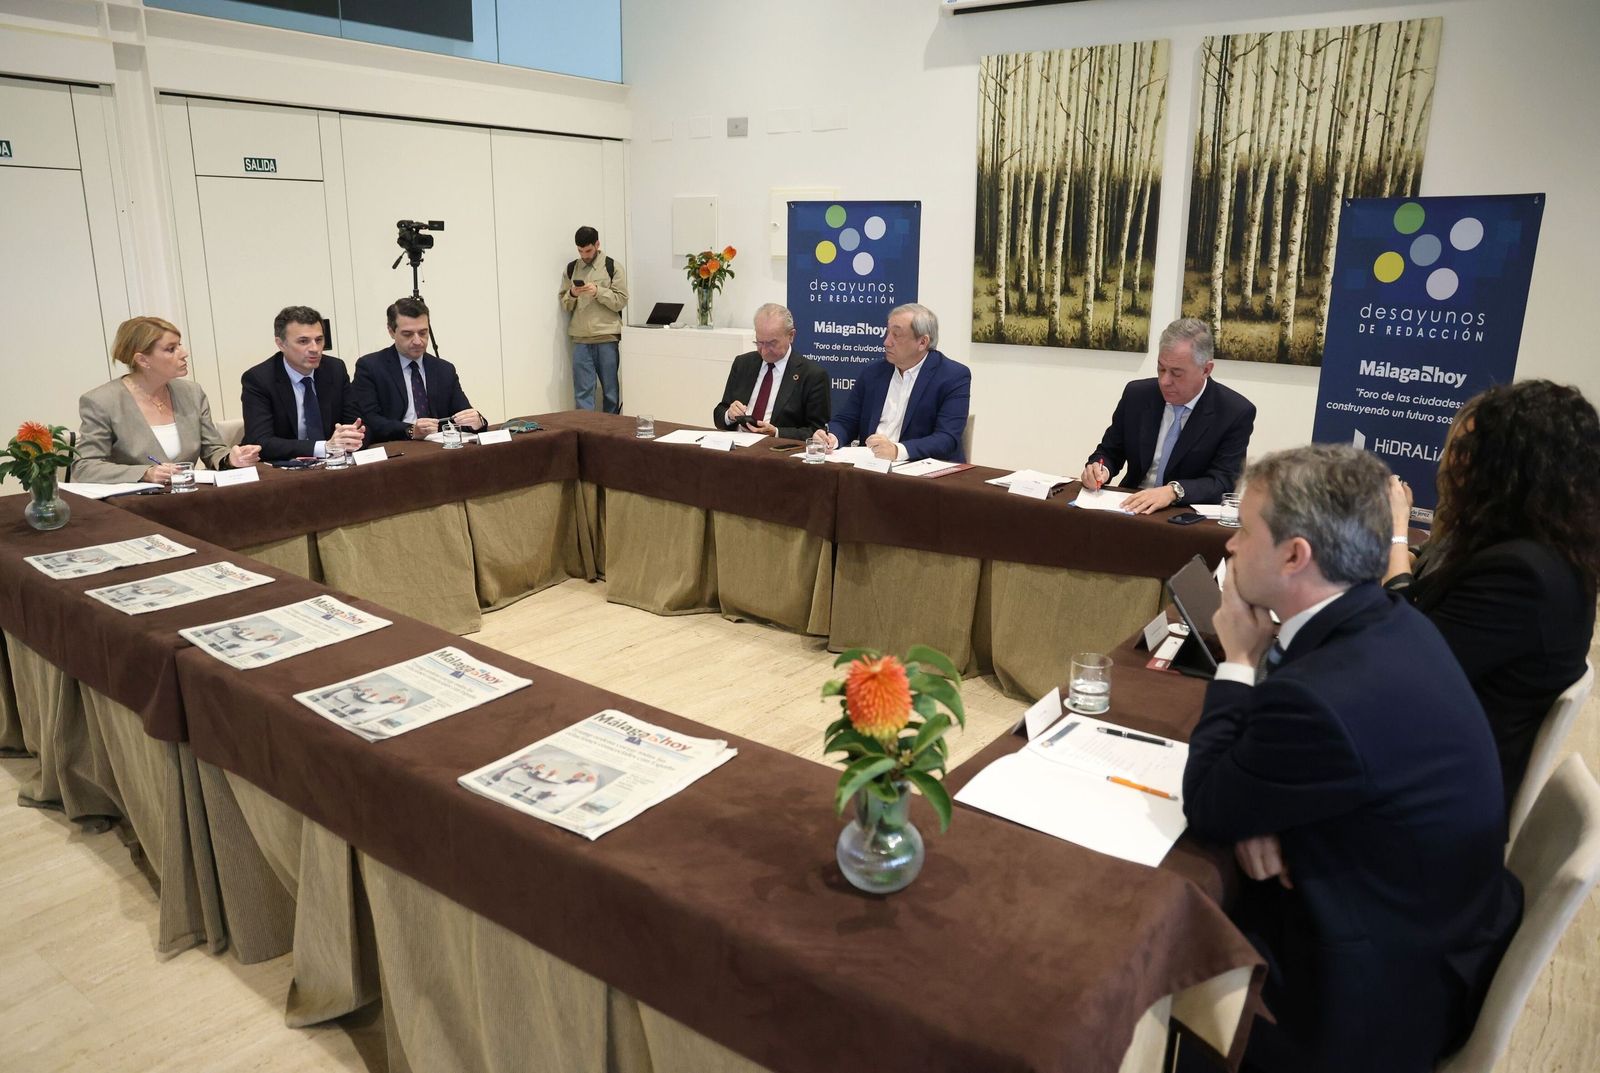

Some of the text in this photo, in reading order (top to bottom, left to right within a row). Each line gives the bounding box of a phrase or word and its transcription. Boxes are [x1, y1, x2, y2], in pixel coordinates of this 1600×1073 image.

[245, 158, 276, 172] SALIDA
[809, 279, 894, 293] desayunos
[810, 294, 895, 304] DE REDACCIÓN
[1359, 303, 1486, 326] desayunos
[1359, 323, 1484, 342] DE REDACCIÓN
[831, 342, 841, 351] de
[842, 343, 852, 351] las
[1381, 391, 1395, 401] de
[1396, 392, 1411, 403] las
[1326, 401, 1390, 415] construyendo
[1392, 410, 1404, 418] un
[1406, 410, 1435, 422] futuro
